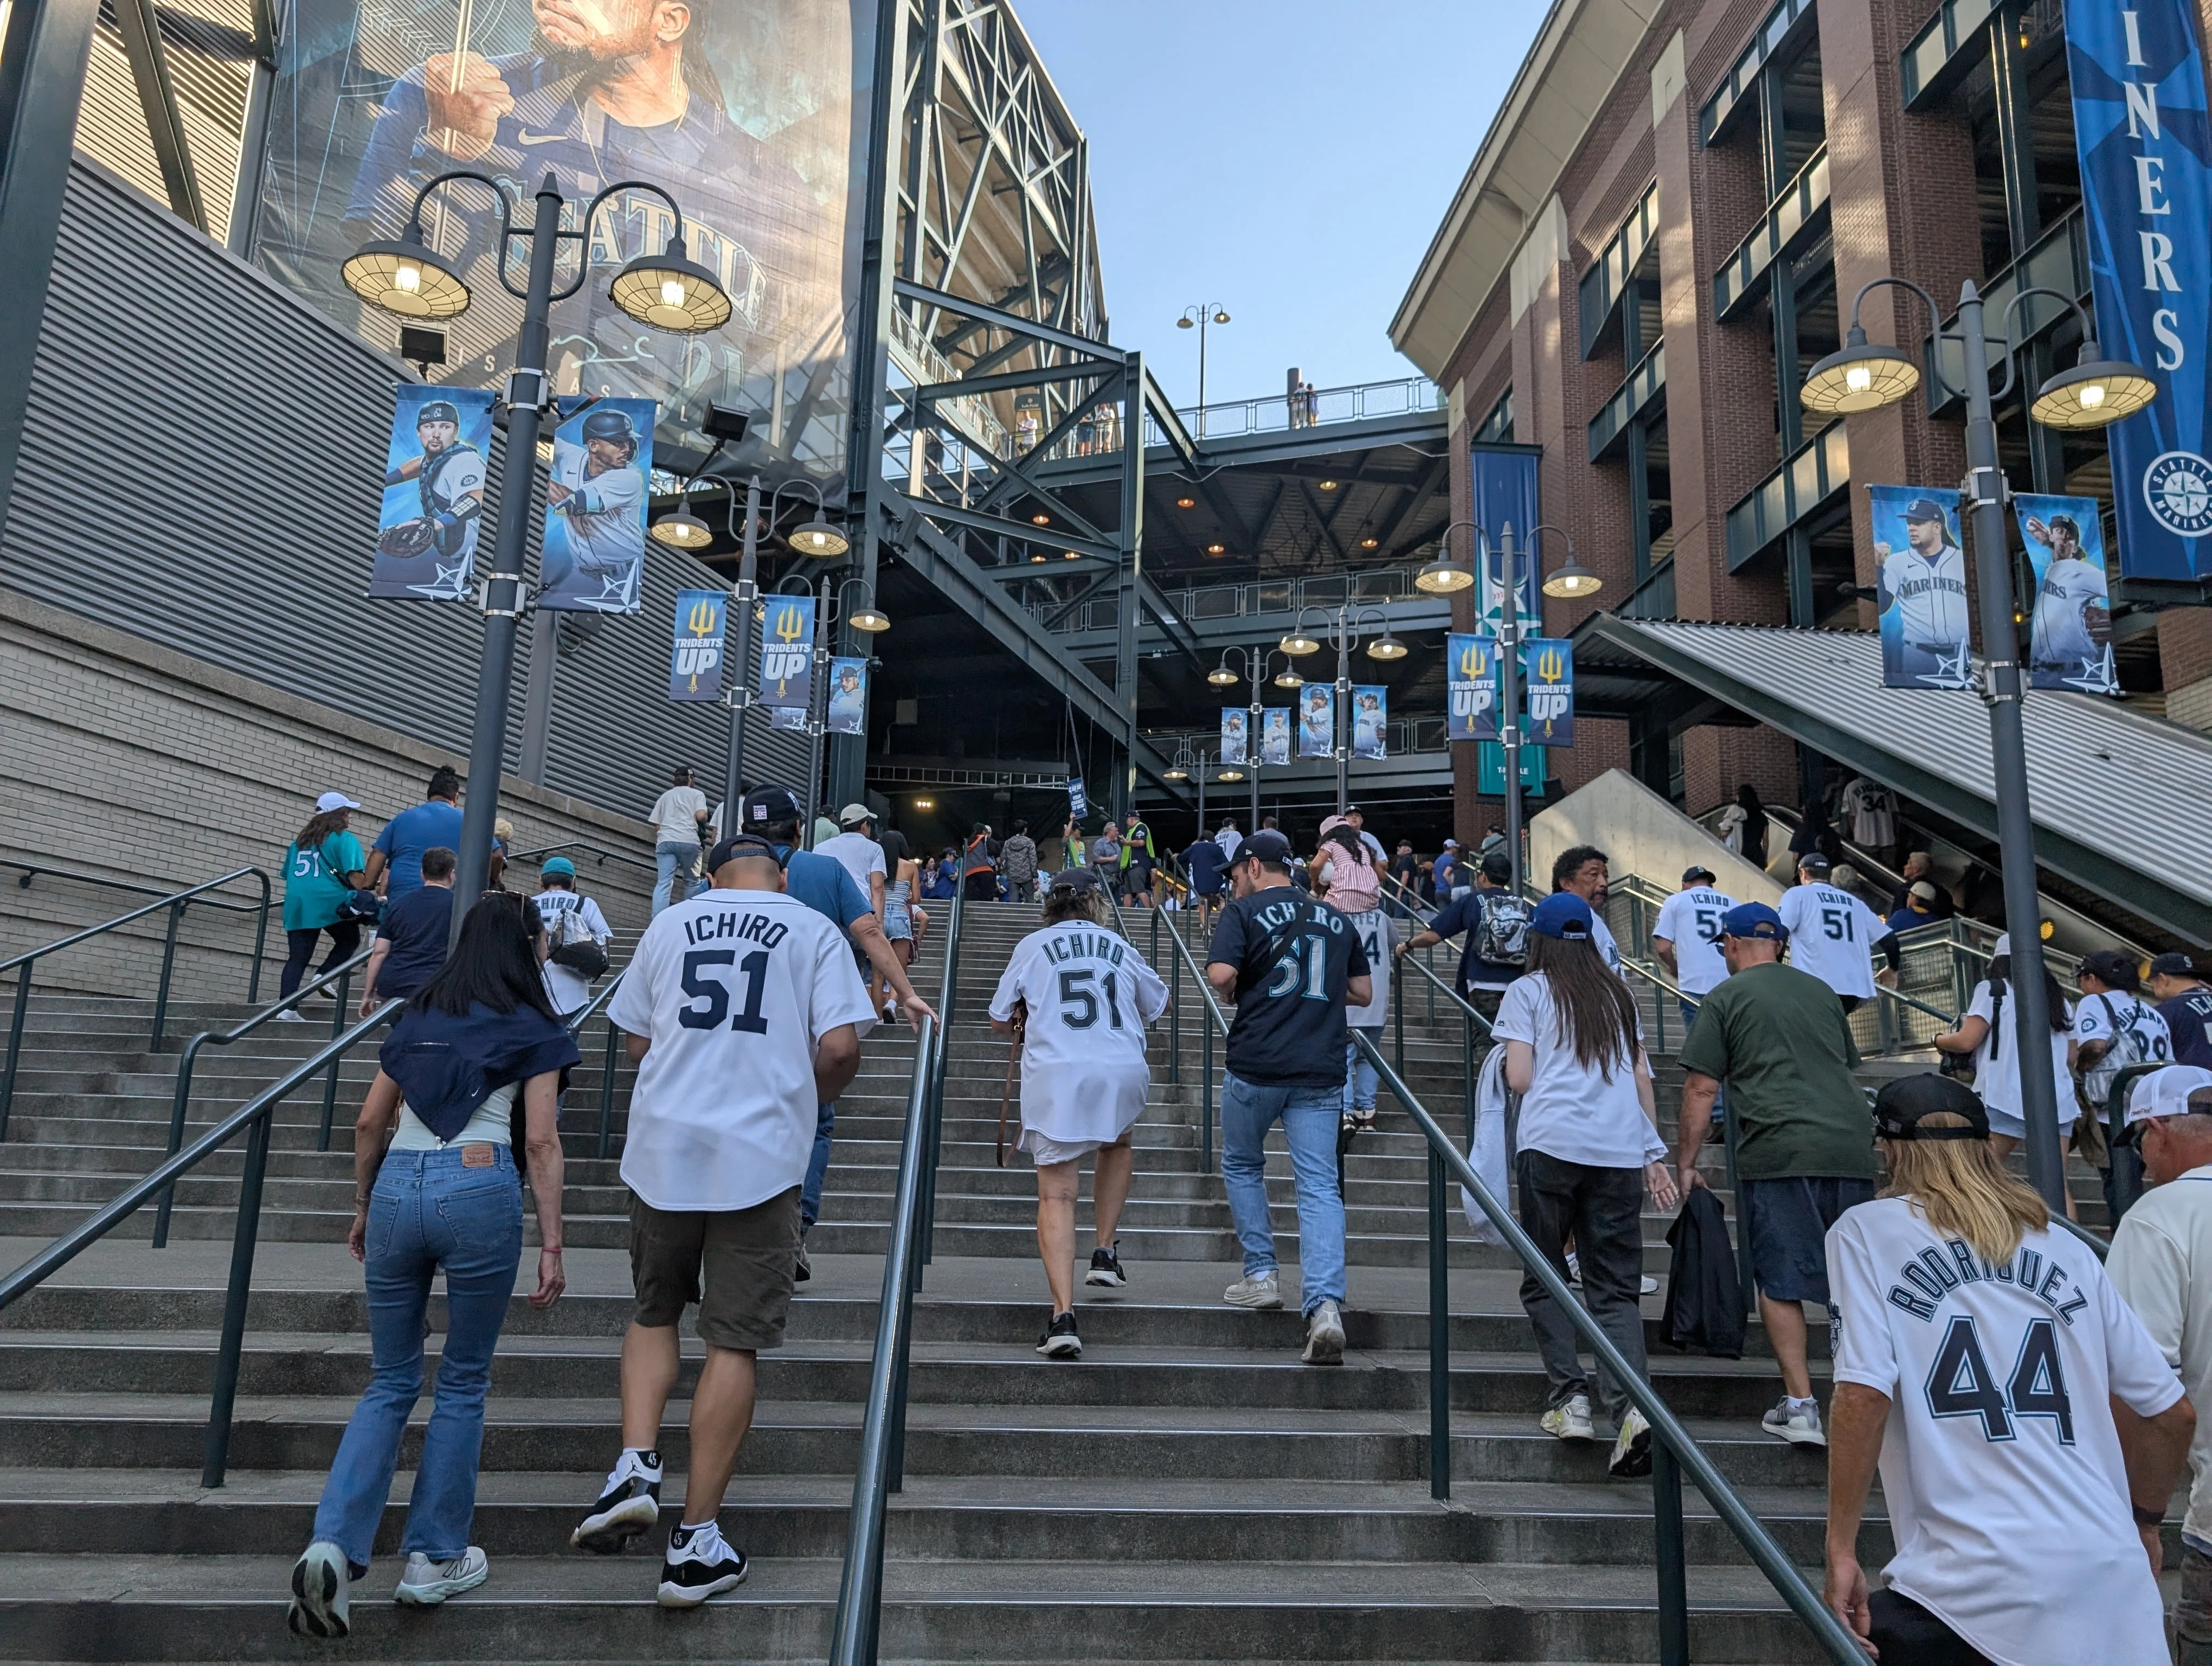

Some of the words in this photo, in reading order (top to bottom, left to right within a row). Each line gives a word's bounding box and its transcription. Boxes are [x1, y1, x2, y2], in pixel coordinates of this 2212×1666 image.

[2155, 499, 2212, 529] MARINER
[675, 638, 723, 649] TRIDENTS
[763, 643, 811, 654] TRIDENTS
[676, 649, 718, 675] UP
[764, 654, 806, 680] UP
[1449, 680, 1495, 691] TRIDENTS
[1528, 684, 1571, 695] TRIDENTS
[1452, 691, 1491, 716] UP
[1531, 695, 1568, 720] UP
[1861, 795, 1886, 812] 34
[294, 850, 320, 877] 51
[541, 897, 576, 910] HIRO
[1690, 894, 1729, 907] ICHIRO
[1817, 892, 1853, 906] ICHIRO
[684, 912, 789, 949] ICHIRO
[1253, 901, 1343, 935] ICHRO
[1351, 912, 1380, 927] FFEY
[1822, 908, 1854, 943] 51
[1041, 933, 1124, 967] ICHIRO
[1364, 931, 1380, 966] 4
[1269, 934, 1329, 1001] 51
[678, 949, 769, 1035] 51
[1058, 968, 1124, 1030] 51
[1923, 1315, 2076, 1447] 44
[648, 1452, 657, 1466] 45
[673, 1532, 682, 1546] 45
